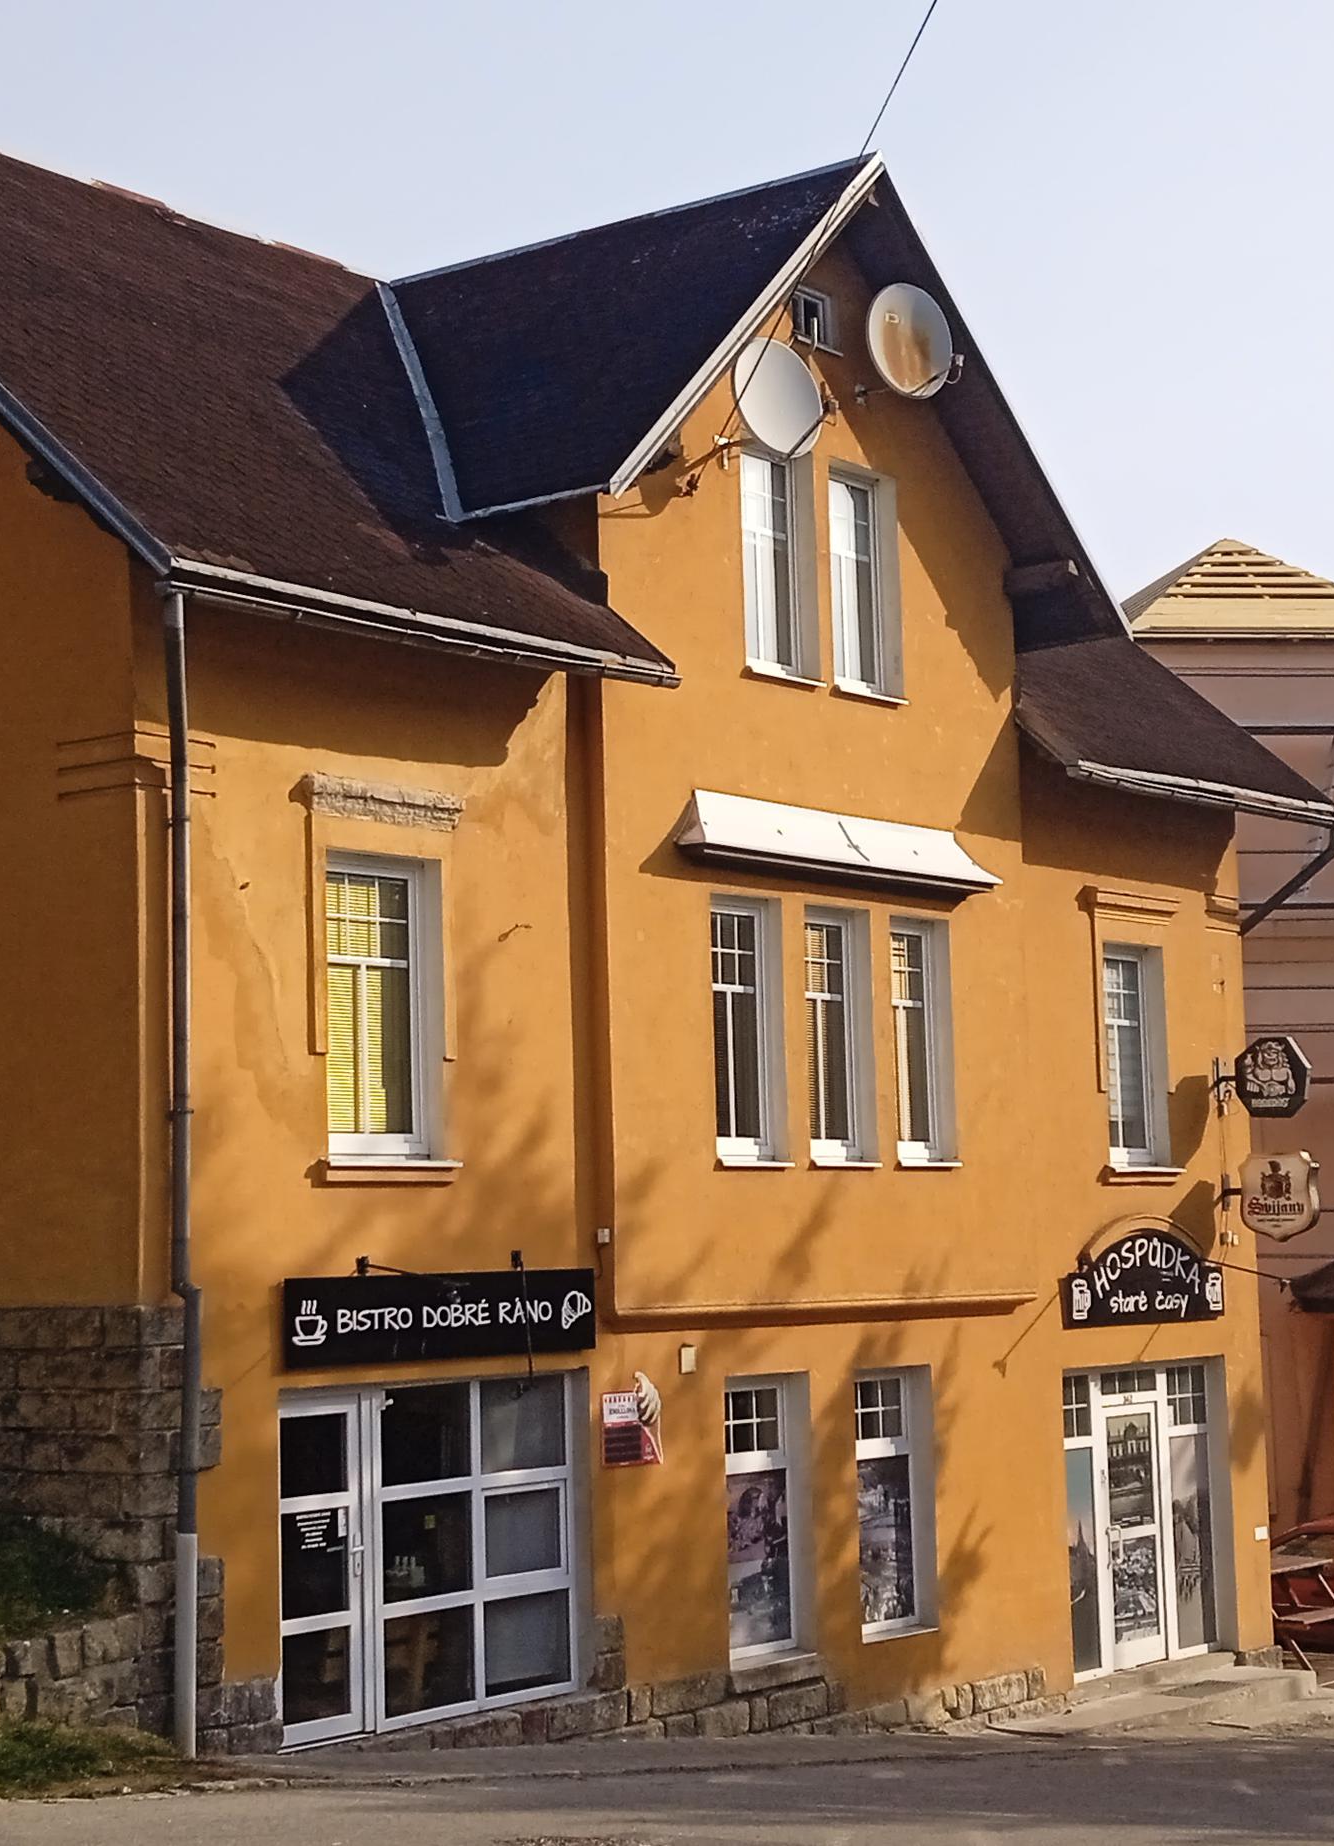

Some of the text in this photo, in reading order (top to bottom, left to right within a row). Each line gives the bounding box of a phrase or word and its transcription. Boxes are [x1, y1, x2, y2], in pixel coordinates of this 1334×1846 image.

[1247, 1196, 1304, 1216] Svijany
[1093, 1237, 1201, 1299] HOSPŮDKA
[337, 1297, 553, 1334] BISTRO DOBRÉ RÁNO
[1110, 1289, 1188, 1318] staré časy
